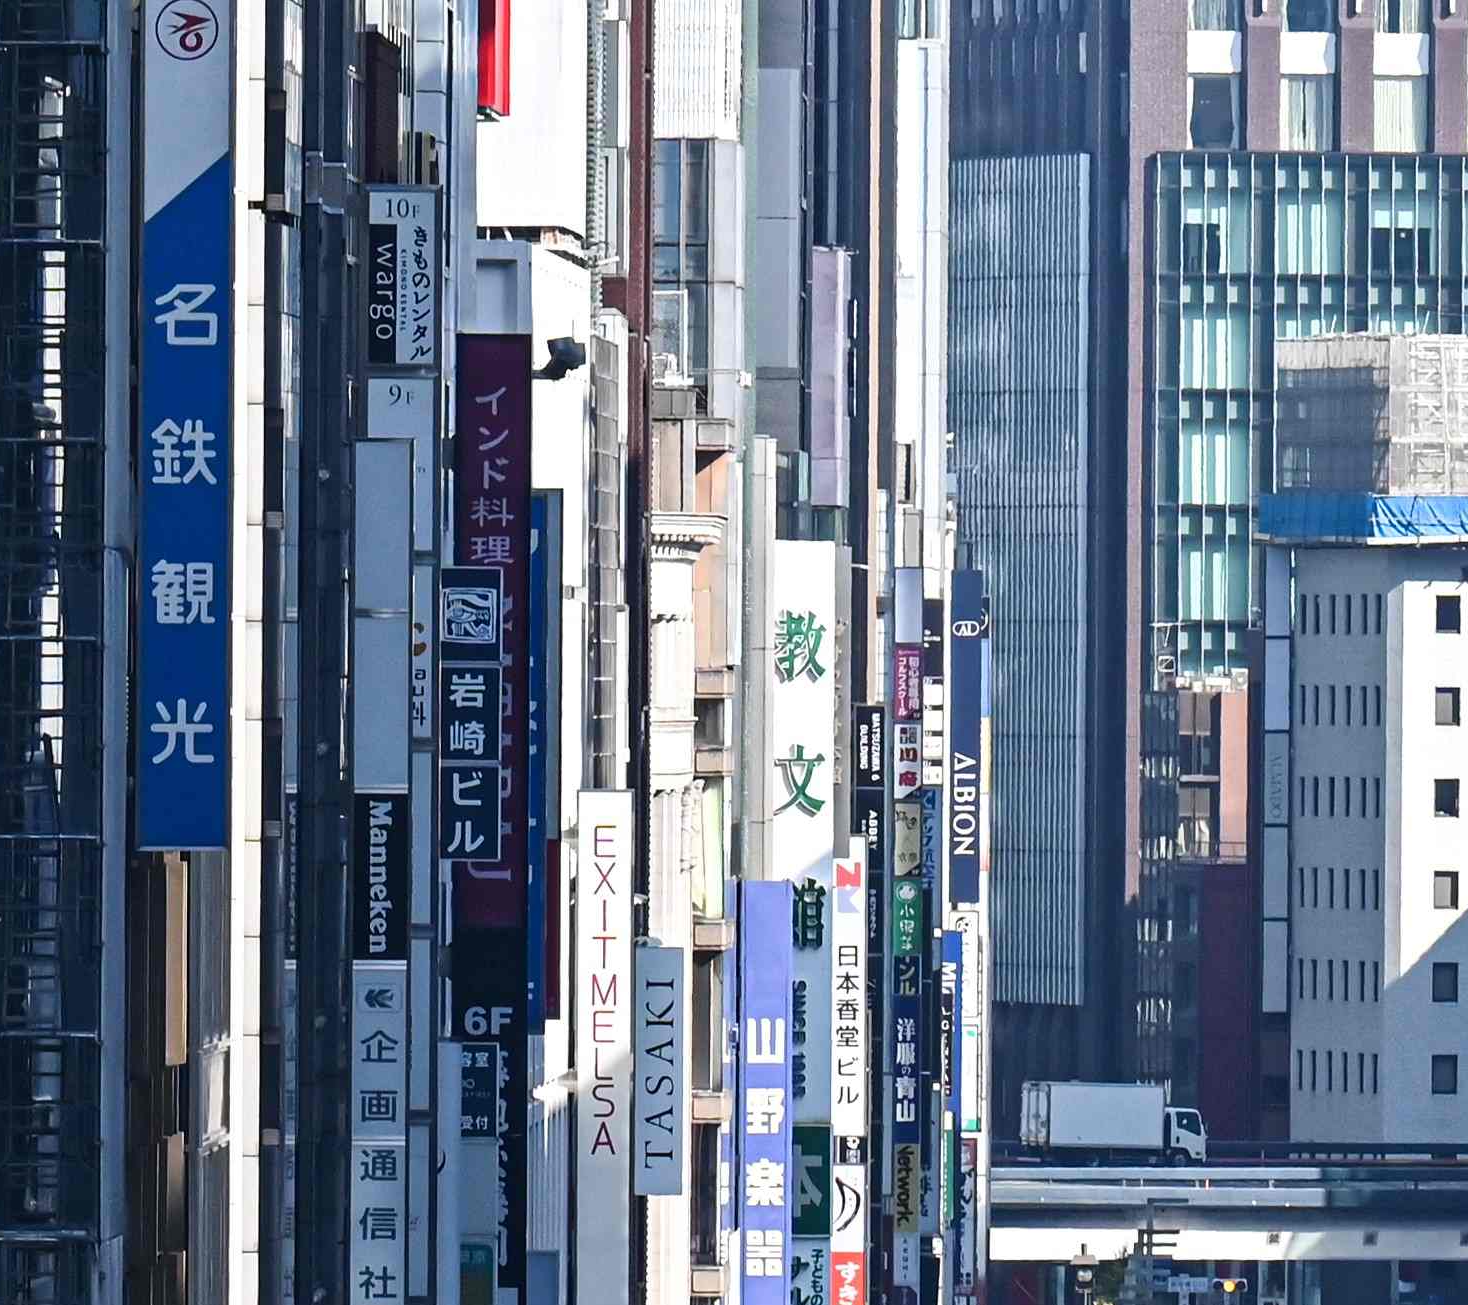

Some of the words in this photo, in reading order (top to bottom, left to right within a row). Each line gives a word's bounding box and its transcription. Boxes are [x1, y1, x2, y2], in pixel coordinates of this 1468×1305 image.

[370, 243, 394, 341] wargo
[411, 226, 431, 361] きものレンタル
[149, 283, 220, 765] 名鉄観光
[470, 387, 515, 565] インド料理
[447, 672, 487, 853] 岩崎ビル
[953, 751, 976, 856] ALBION
[369, 800, 394, 954] Manneken
[464, 1006, 513, 1036] 6F
[591, 824, 617, 1156] EXITMELSA
[644, 978, 675, 1169] TASAKI
[834, 945, 860, 1105] 日本香堂ビル
[894, 1017, 917, 1123] 洋服の青山
[359, 1029, 399, 1300] 企画通信社
[745, 1017, 786, 1278] 山野楽器
